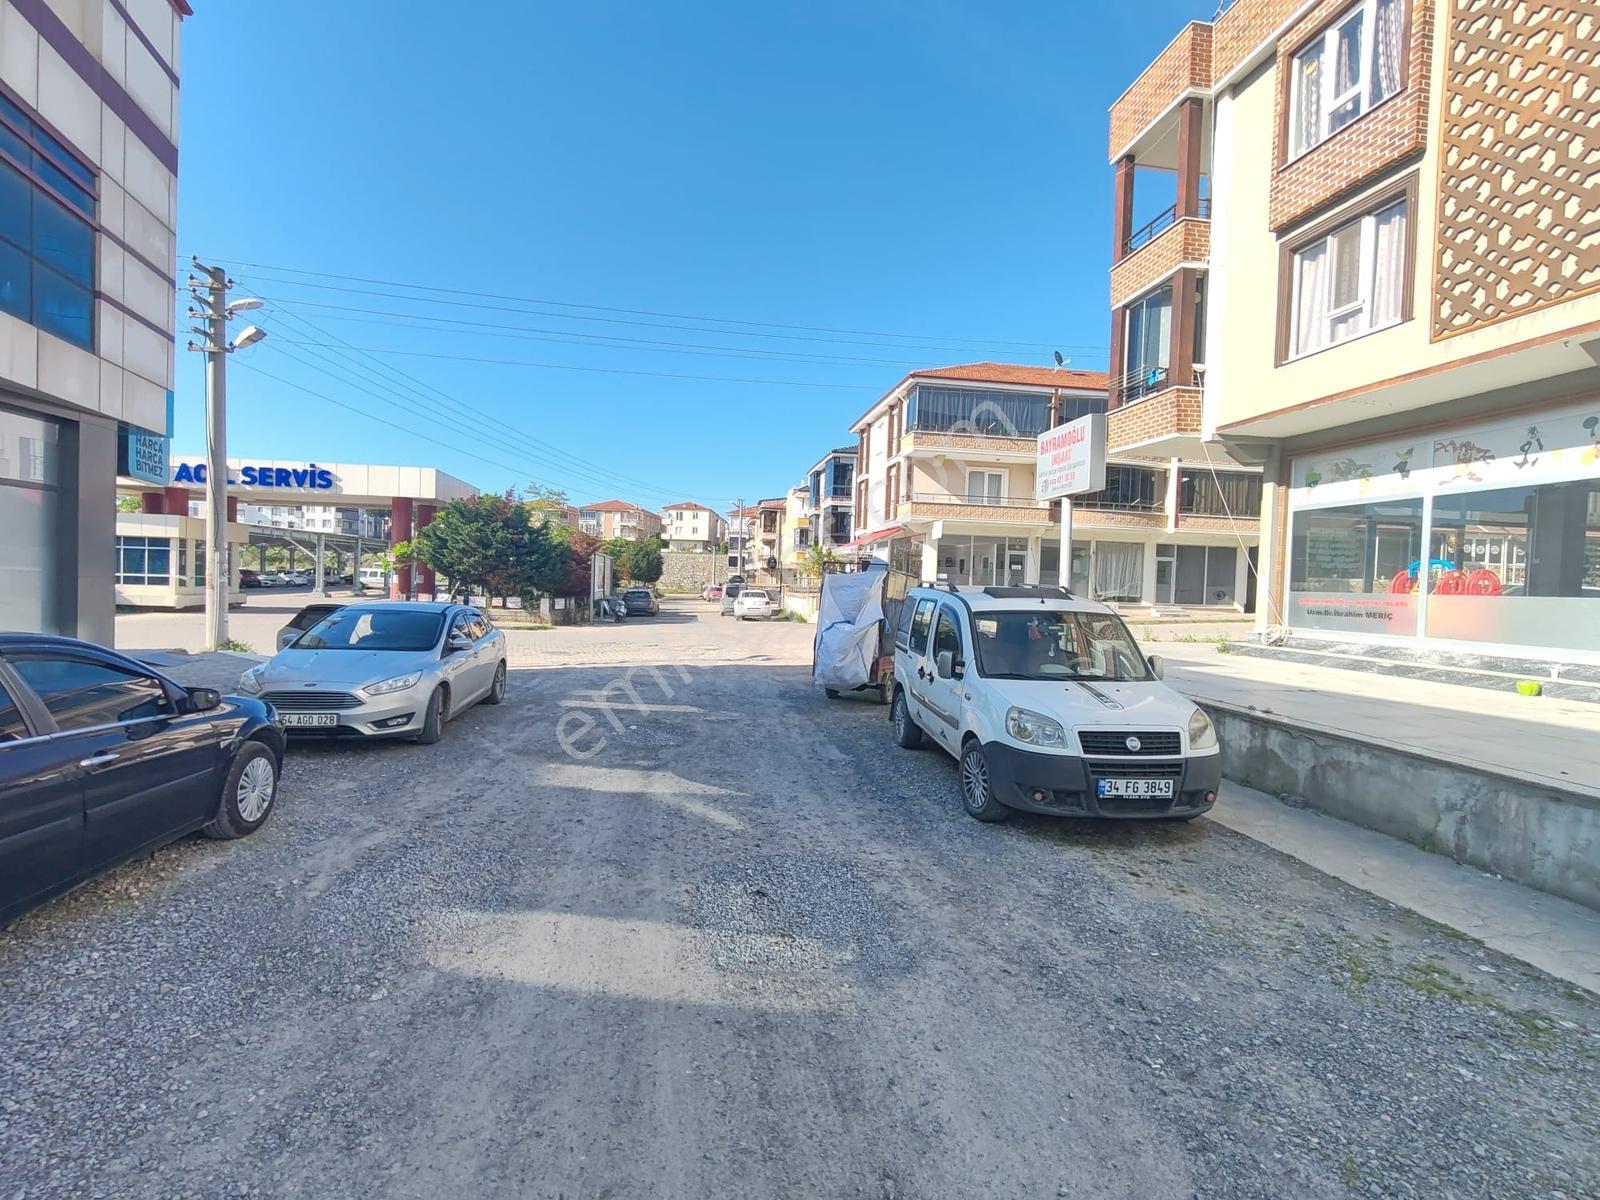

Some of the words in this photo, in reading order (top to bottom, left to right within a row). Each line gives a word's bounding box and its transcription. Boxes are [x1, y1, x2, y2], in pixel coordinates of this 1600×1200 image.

[1040, 425, 1085, 456] BAYRAMOĞLU
[135, 447, 163, 466] HARCA
[175, 463, 235, 484] AC
[241, 463, 332, 489] SERVİS
[1366, 611, 1393, 621] MERİÇ
[317, 715, 335, 725] 028
[1106, 781, 1119, 793] 34
[1125, 781, 1140, 794] FG
[1143, 781, 1171, 794] 3849
